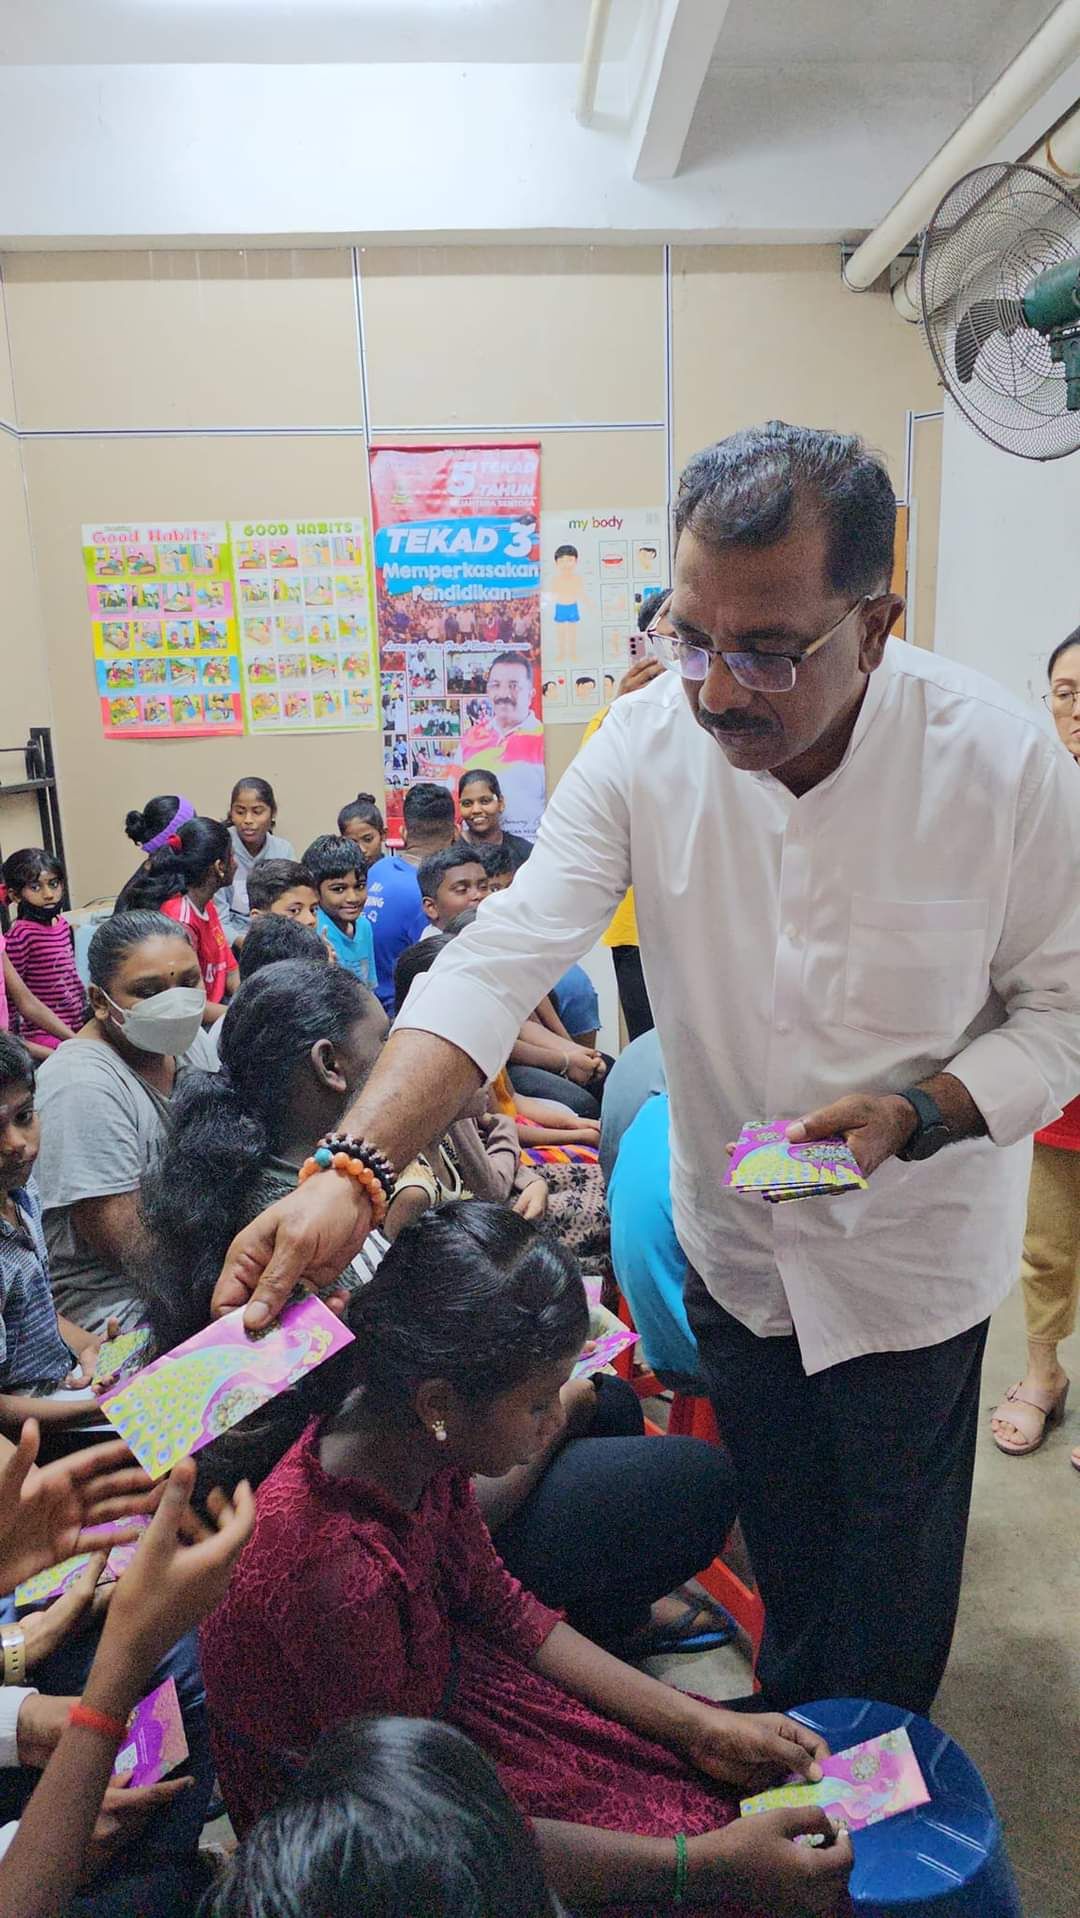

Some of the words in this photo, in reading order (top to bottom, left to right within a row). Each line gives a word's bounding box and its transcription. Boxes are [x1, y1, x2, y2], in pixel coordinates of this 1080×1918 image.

[447, 461, 477, 497] 5
[479, 461, 535, 474] TEKAD
[479, 482, 534, 497] TAHUN
[243, 523, 289, 536] GOOD
[295, 521, 353, 535] HABITS
[568, 518, 588, 531] my
[592, 516, 623, 530] body
[92, 530, 139, 544] Good
[147, 528, 209, 541] Habits
[386, 527, 499, 554] TEKAD
[503, 522, 537, 558] 3
[382, 562, 539, 581] Memperkasakan
[412, 584, 513, 601] Pendidikan
